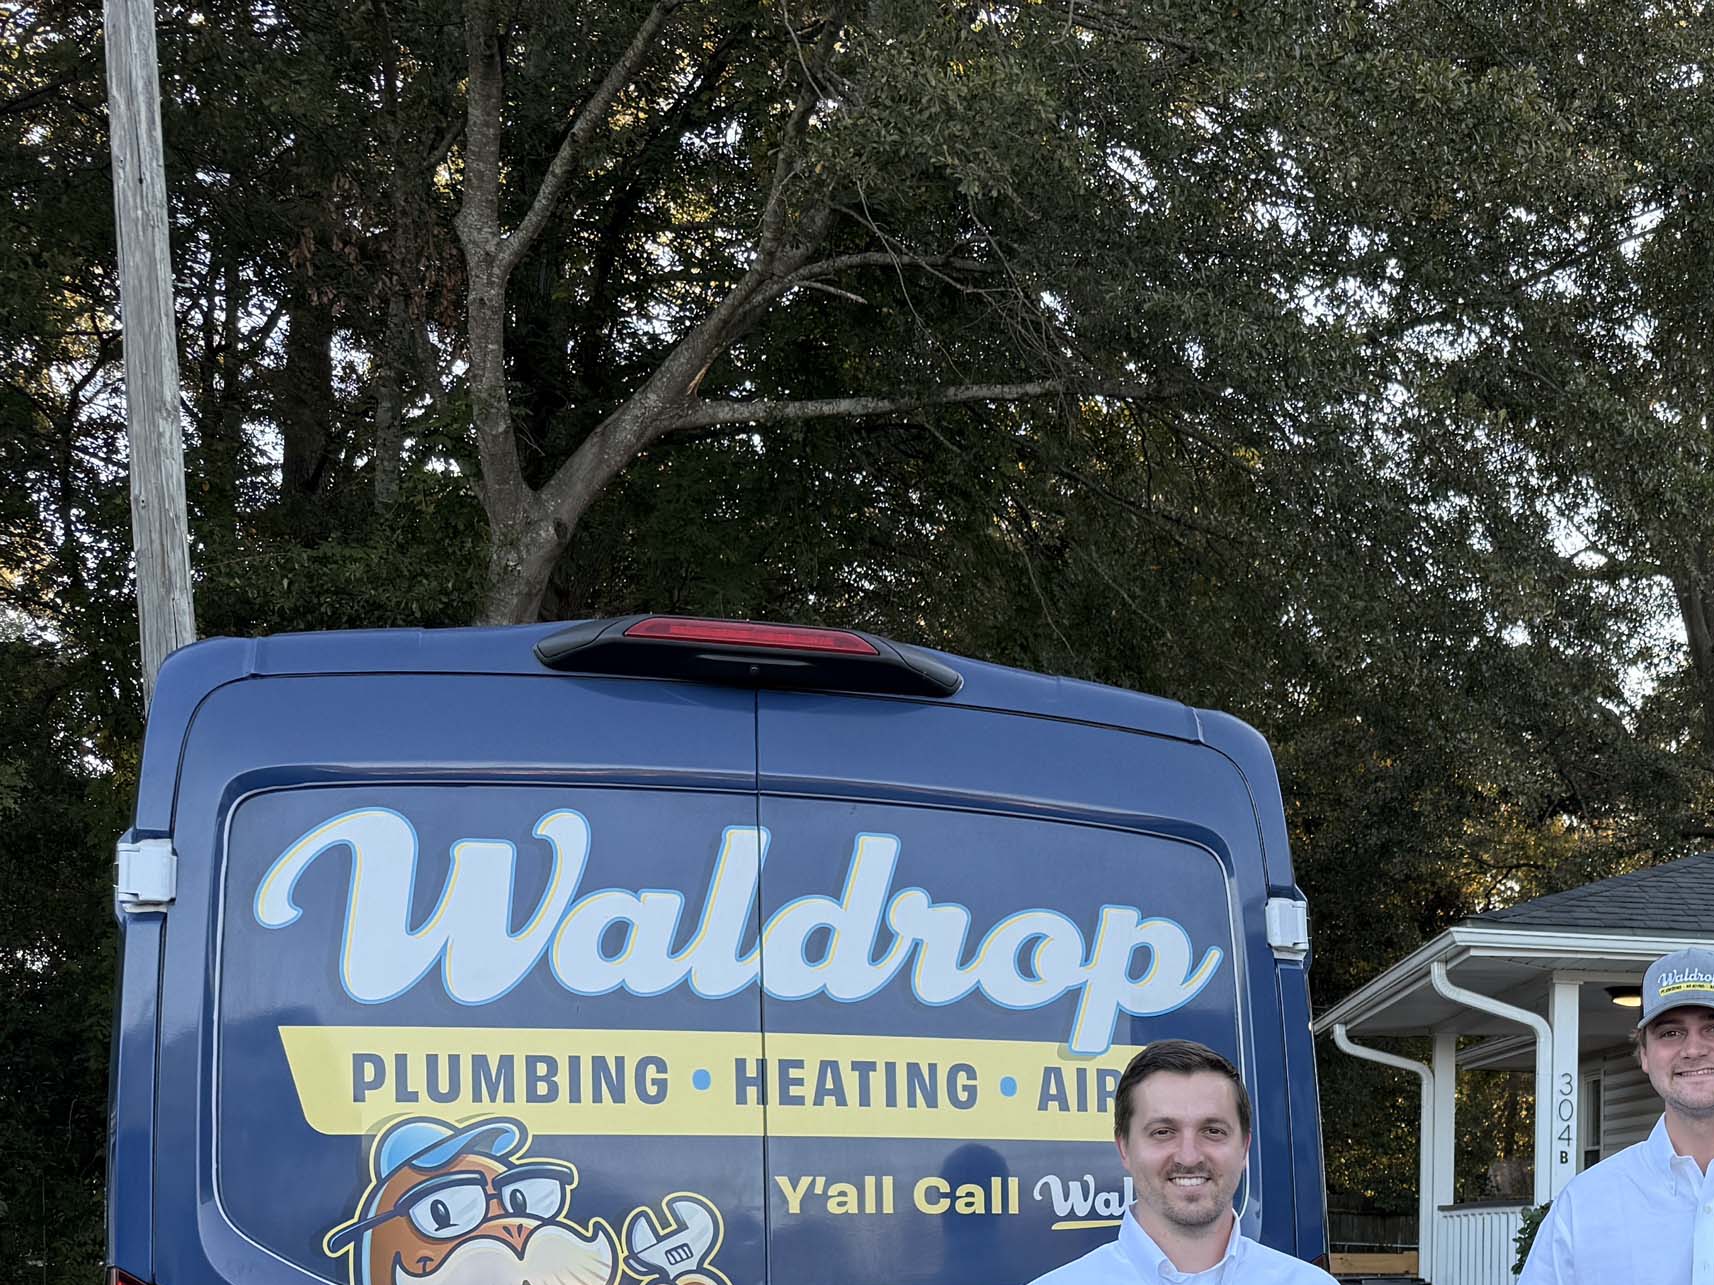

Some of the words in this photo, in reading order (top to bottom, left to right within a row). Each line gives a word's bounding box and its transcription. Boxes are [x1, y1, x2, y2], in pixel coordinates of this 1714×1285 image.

[254, 806, 1224, 1055] Waldrop
[351, 1053, 669, 1105] PLUMBING
[734, 1057, 979, 1111] HEATING
[1557, 1072, 1574, 1147] 304
[1559, 1150, 1569, 1165] B
[775, 1176, 894, 1216] Y'all
[913, 1176, 1020, 1216] Call
